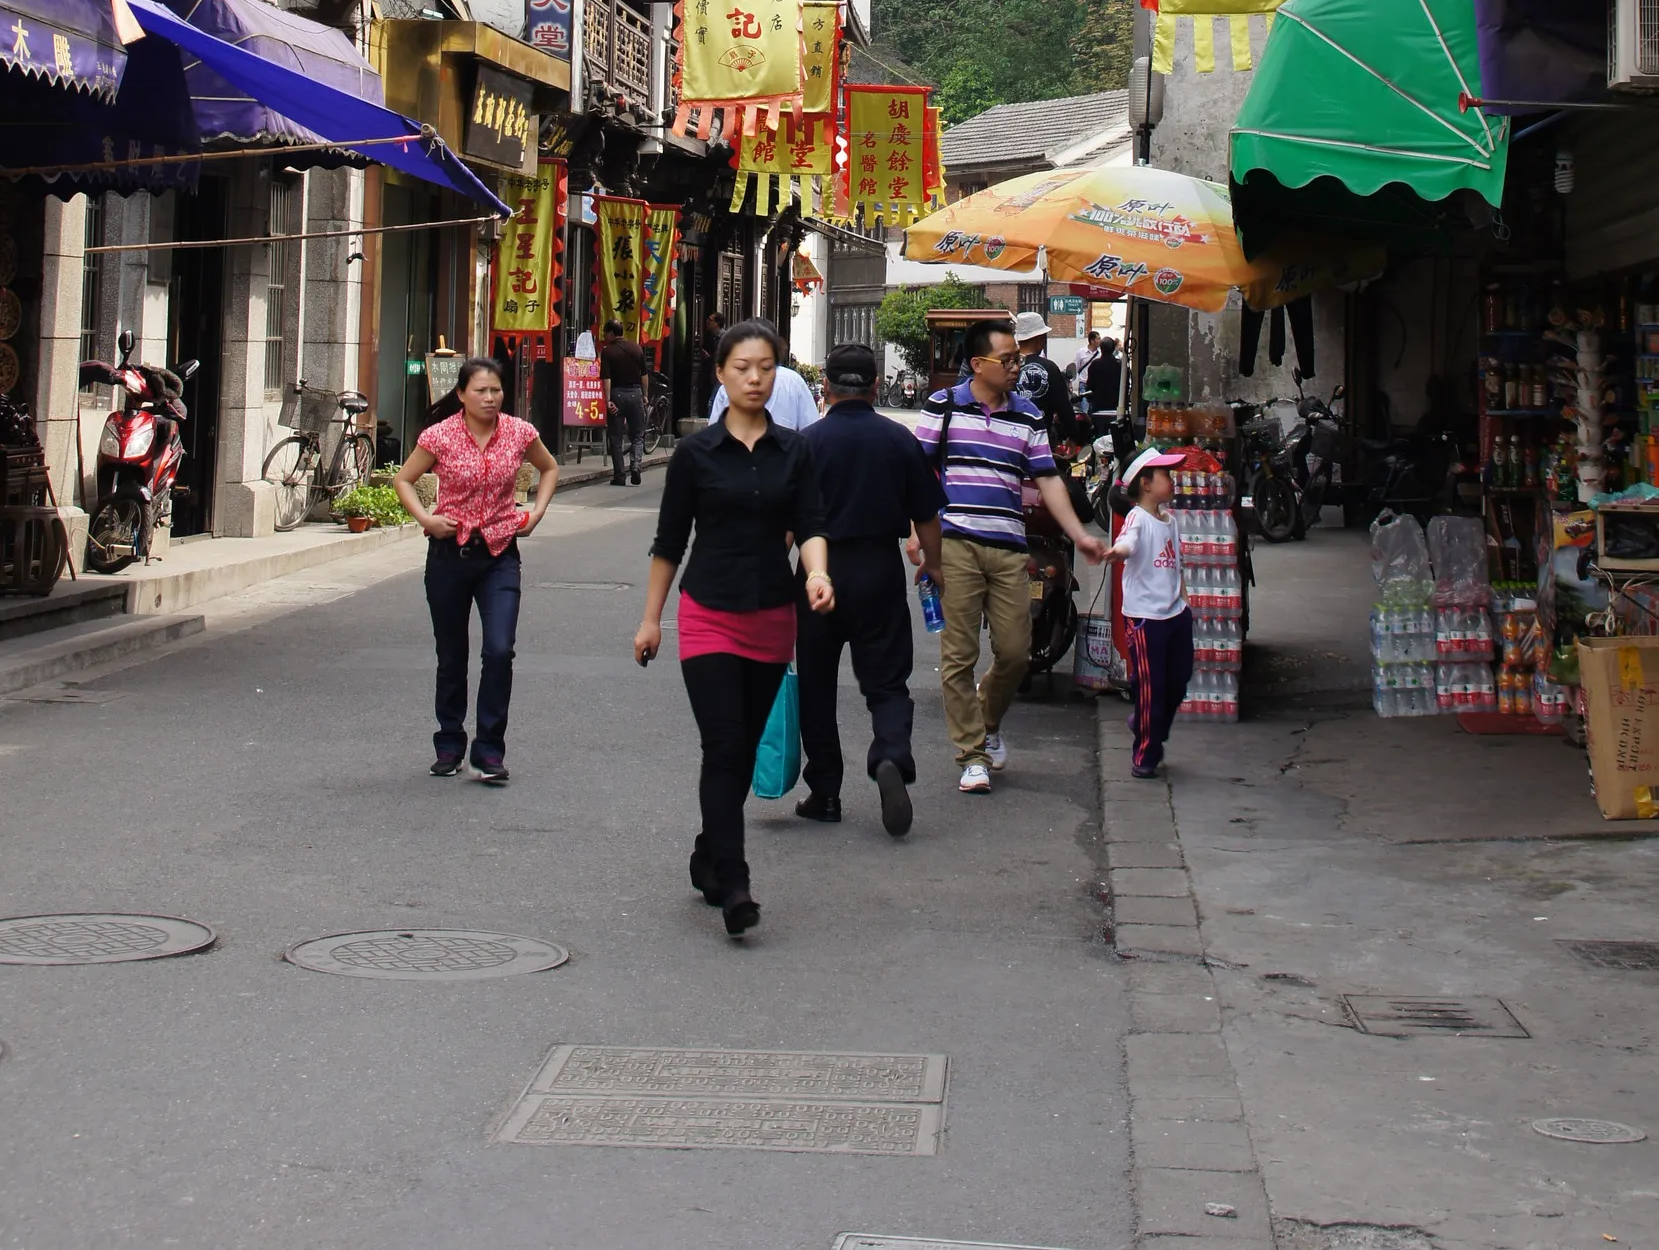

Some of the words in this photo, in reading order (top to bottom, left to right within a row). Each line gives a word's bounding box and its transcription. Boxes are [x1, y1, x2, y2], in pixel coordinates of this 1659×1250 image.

[810, 1, 827, 79] 方直銷
[857, 131, 879, 196] 名醫館
[885, 97, 914, 200] 胡慶餘堂
[507, 198, 539, 295] 王星記
[503, 299, 541, 314] 扇子
